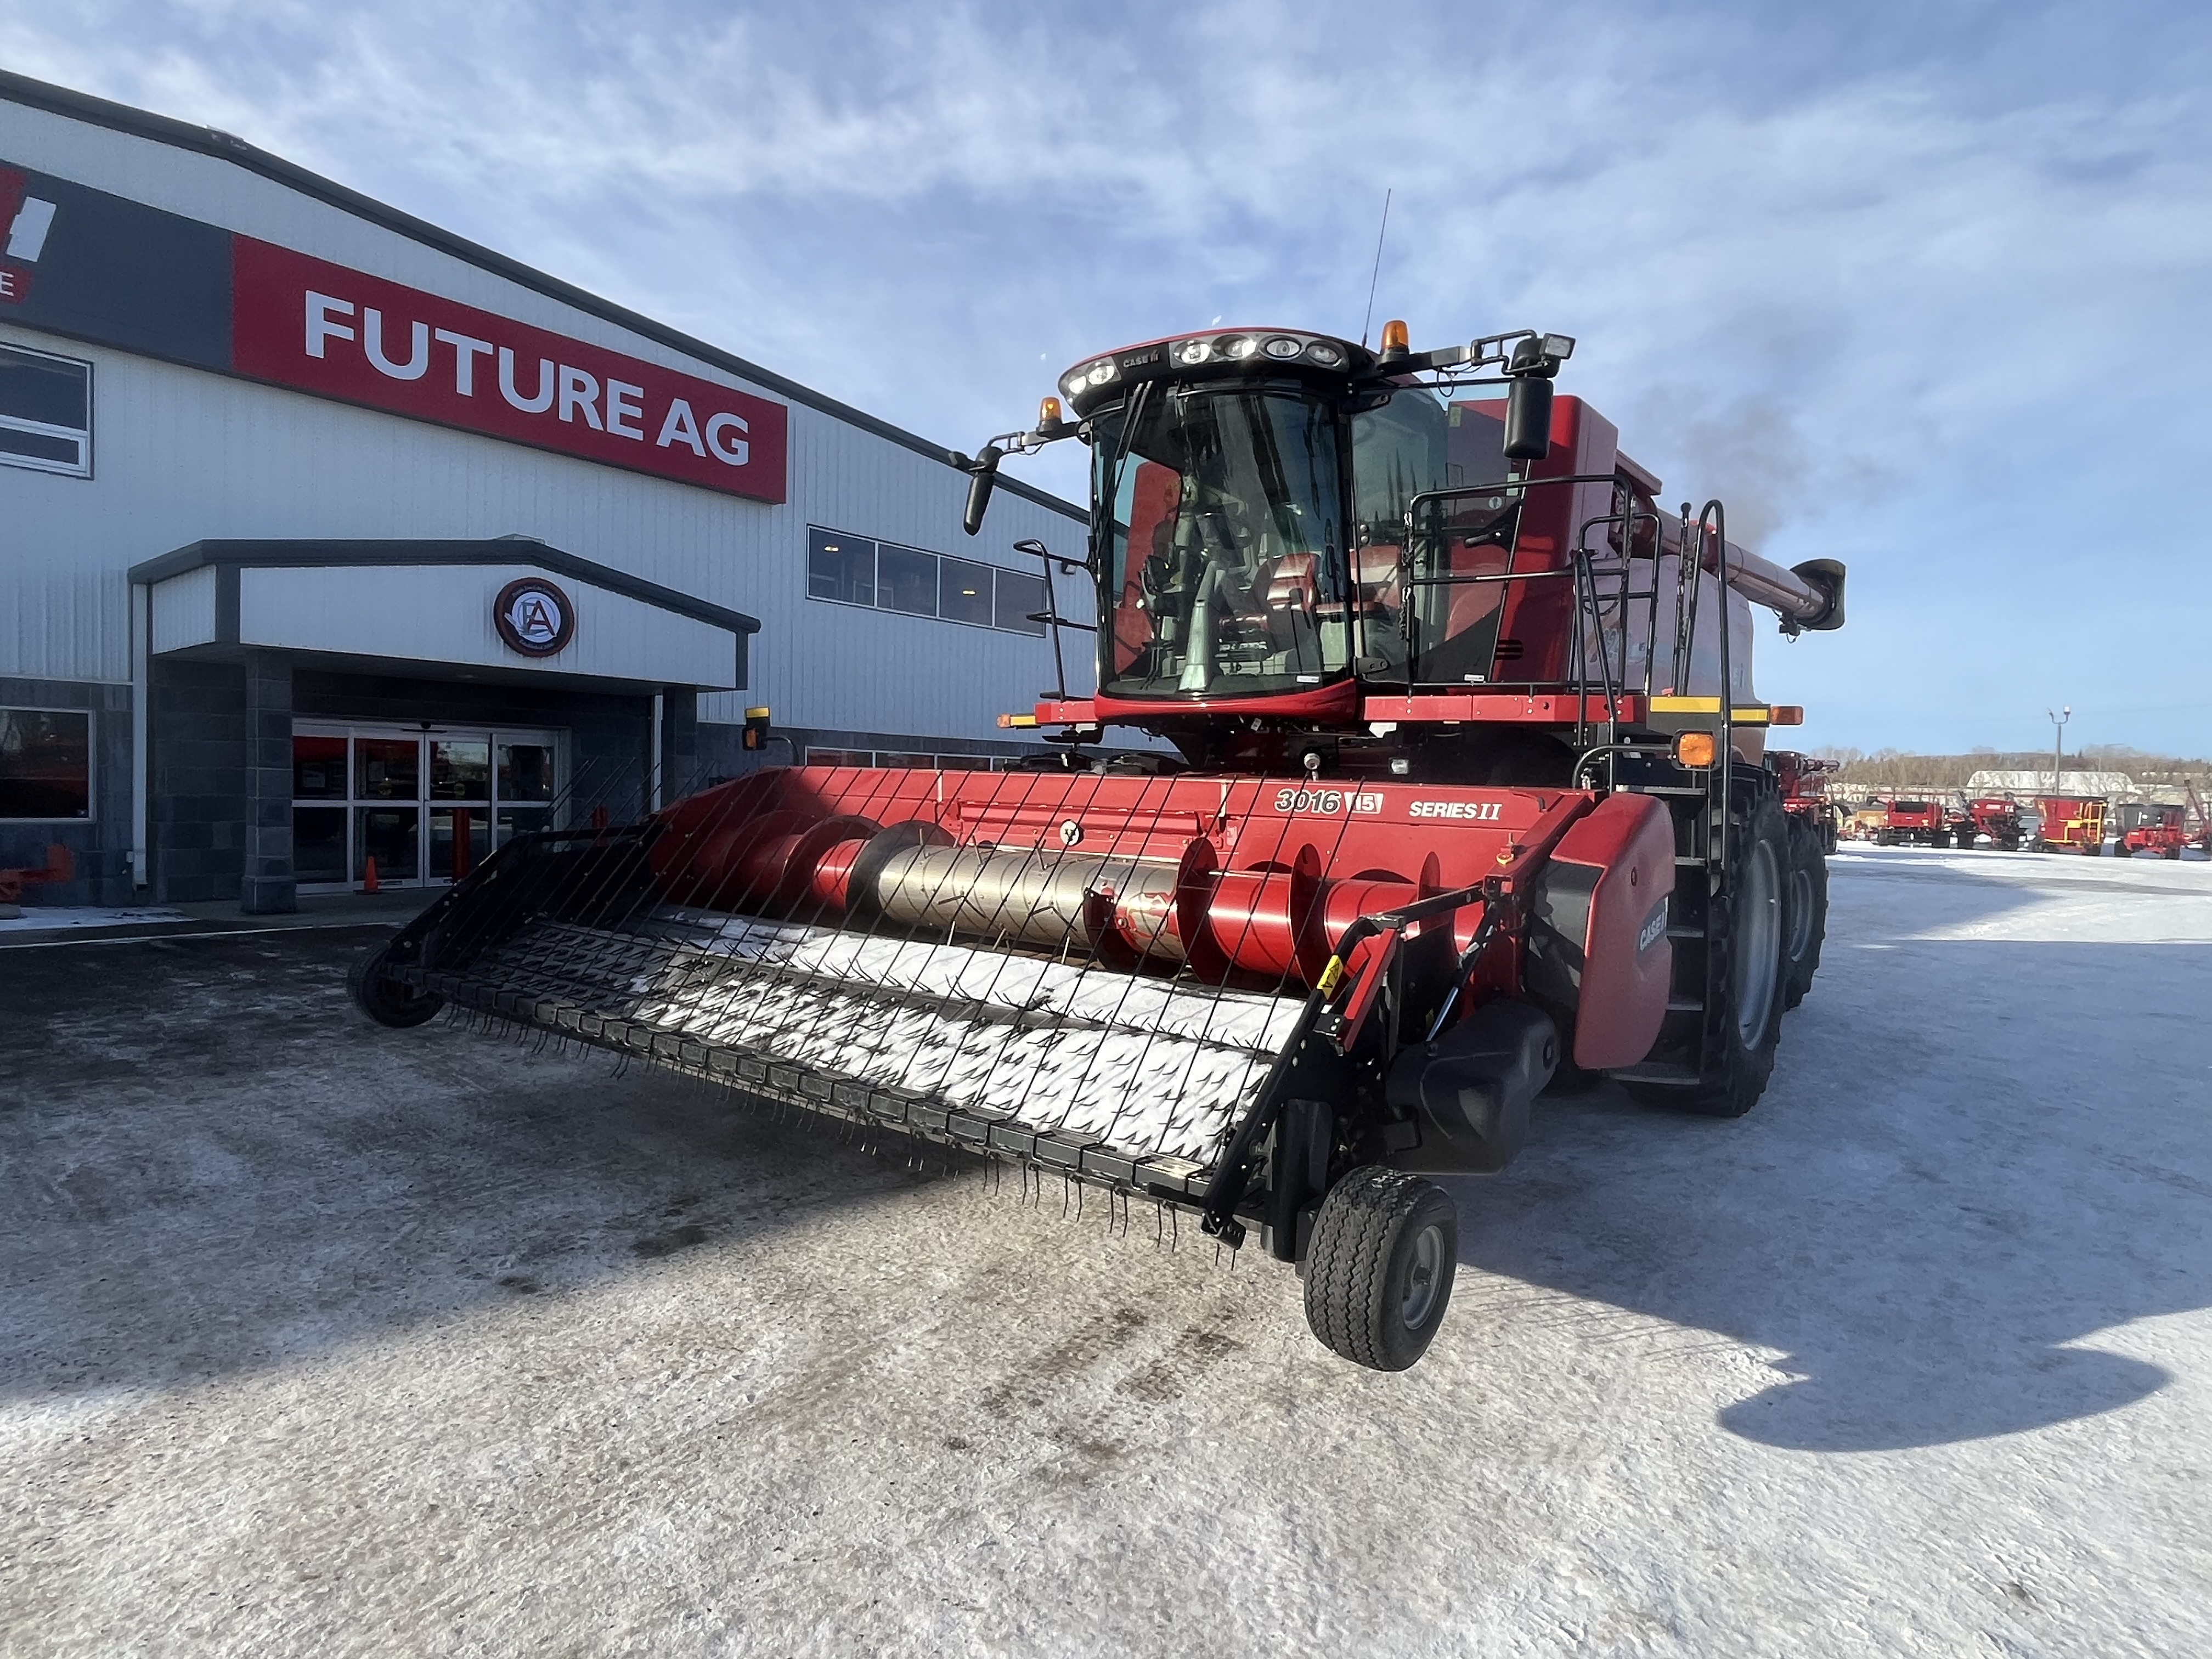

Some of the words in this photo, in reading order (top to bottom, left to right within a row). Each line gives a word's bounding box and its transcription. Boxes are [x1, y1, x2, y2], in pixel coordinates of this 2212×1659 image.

[305, 290, 644, 441] FUTURE
[656, 398, 749, 466] AG
[1123, 354, 1148, 368] CASE
[1274, 788, 1342, 814] 3016
[1409, 801, 1478, 819] SERIES
[1477, 803, 1503, 821] II
[1639, 914, 1661, 952] CASE
